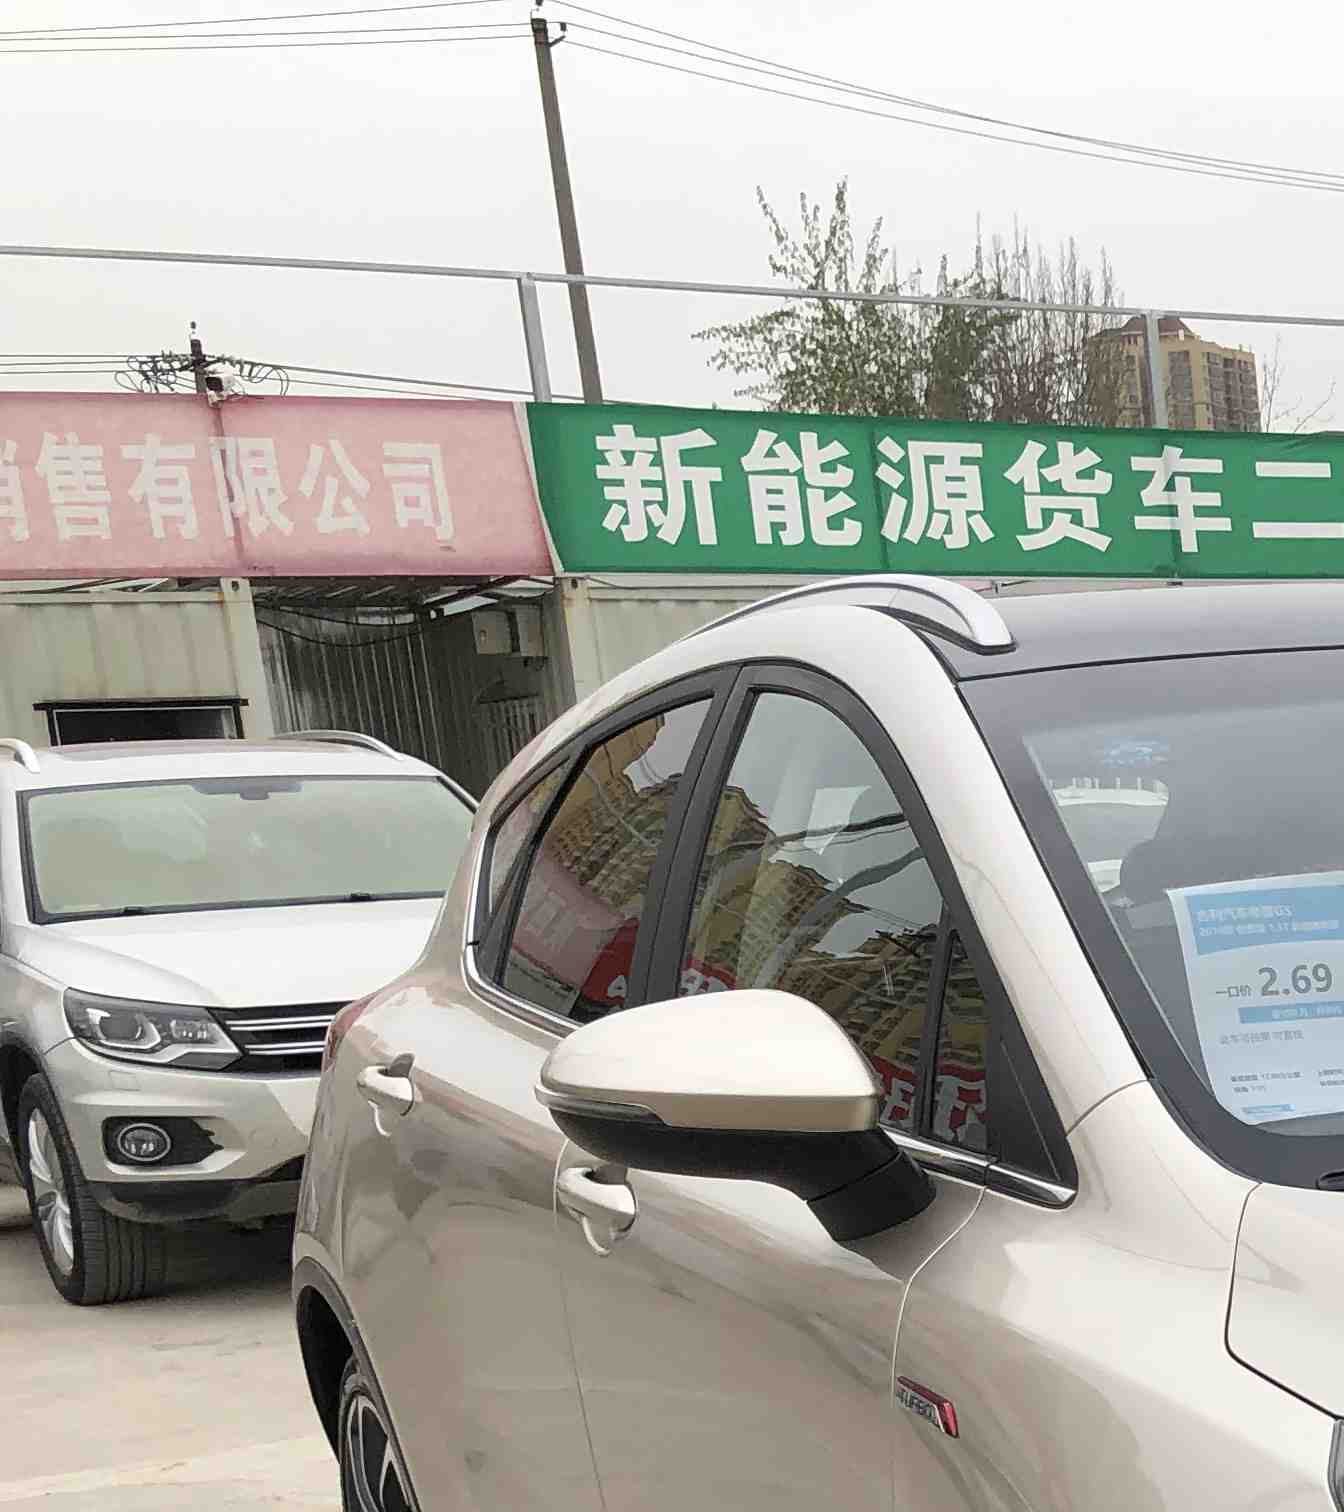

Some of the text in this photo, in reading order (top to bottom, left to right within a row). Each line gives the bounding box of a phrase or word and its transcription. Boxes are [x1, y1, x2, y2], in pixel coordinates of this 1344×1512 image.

[1215, 984, 1253, 998] 一口价
[1258, 963, 1333, 997] 2.69
